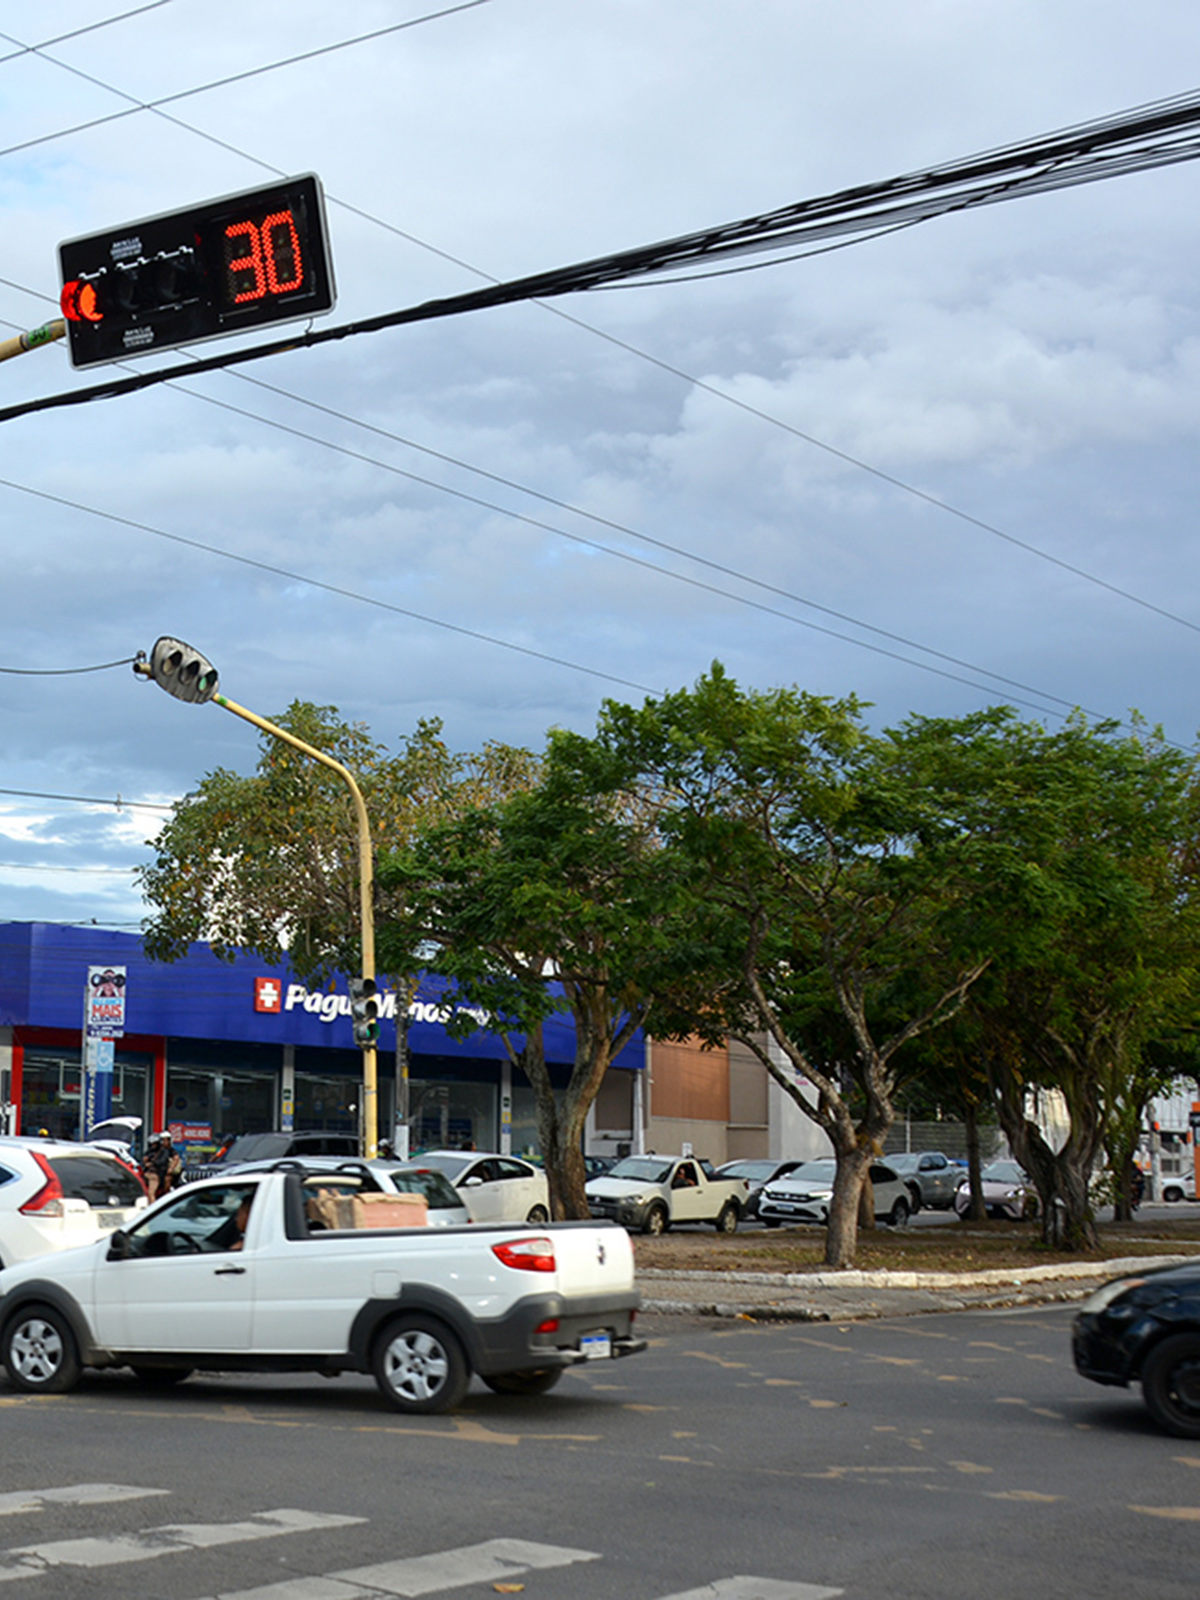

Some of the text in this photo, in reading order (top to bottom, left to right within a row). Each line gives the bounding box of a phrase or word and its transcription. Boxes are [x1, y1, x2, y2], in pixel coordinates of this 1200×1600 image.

[225, 209, 303, 304] 30
[92, 1004, 123, 1017] MAIS
[285, 984, 353, 1022] Pagu
[372, 992, 453, 1024] Mnos
